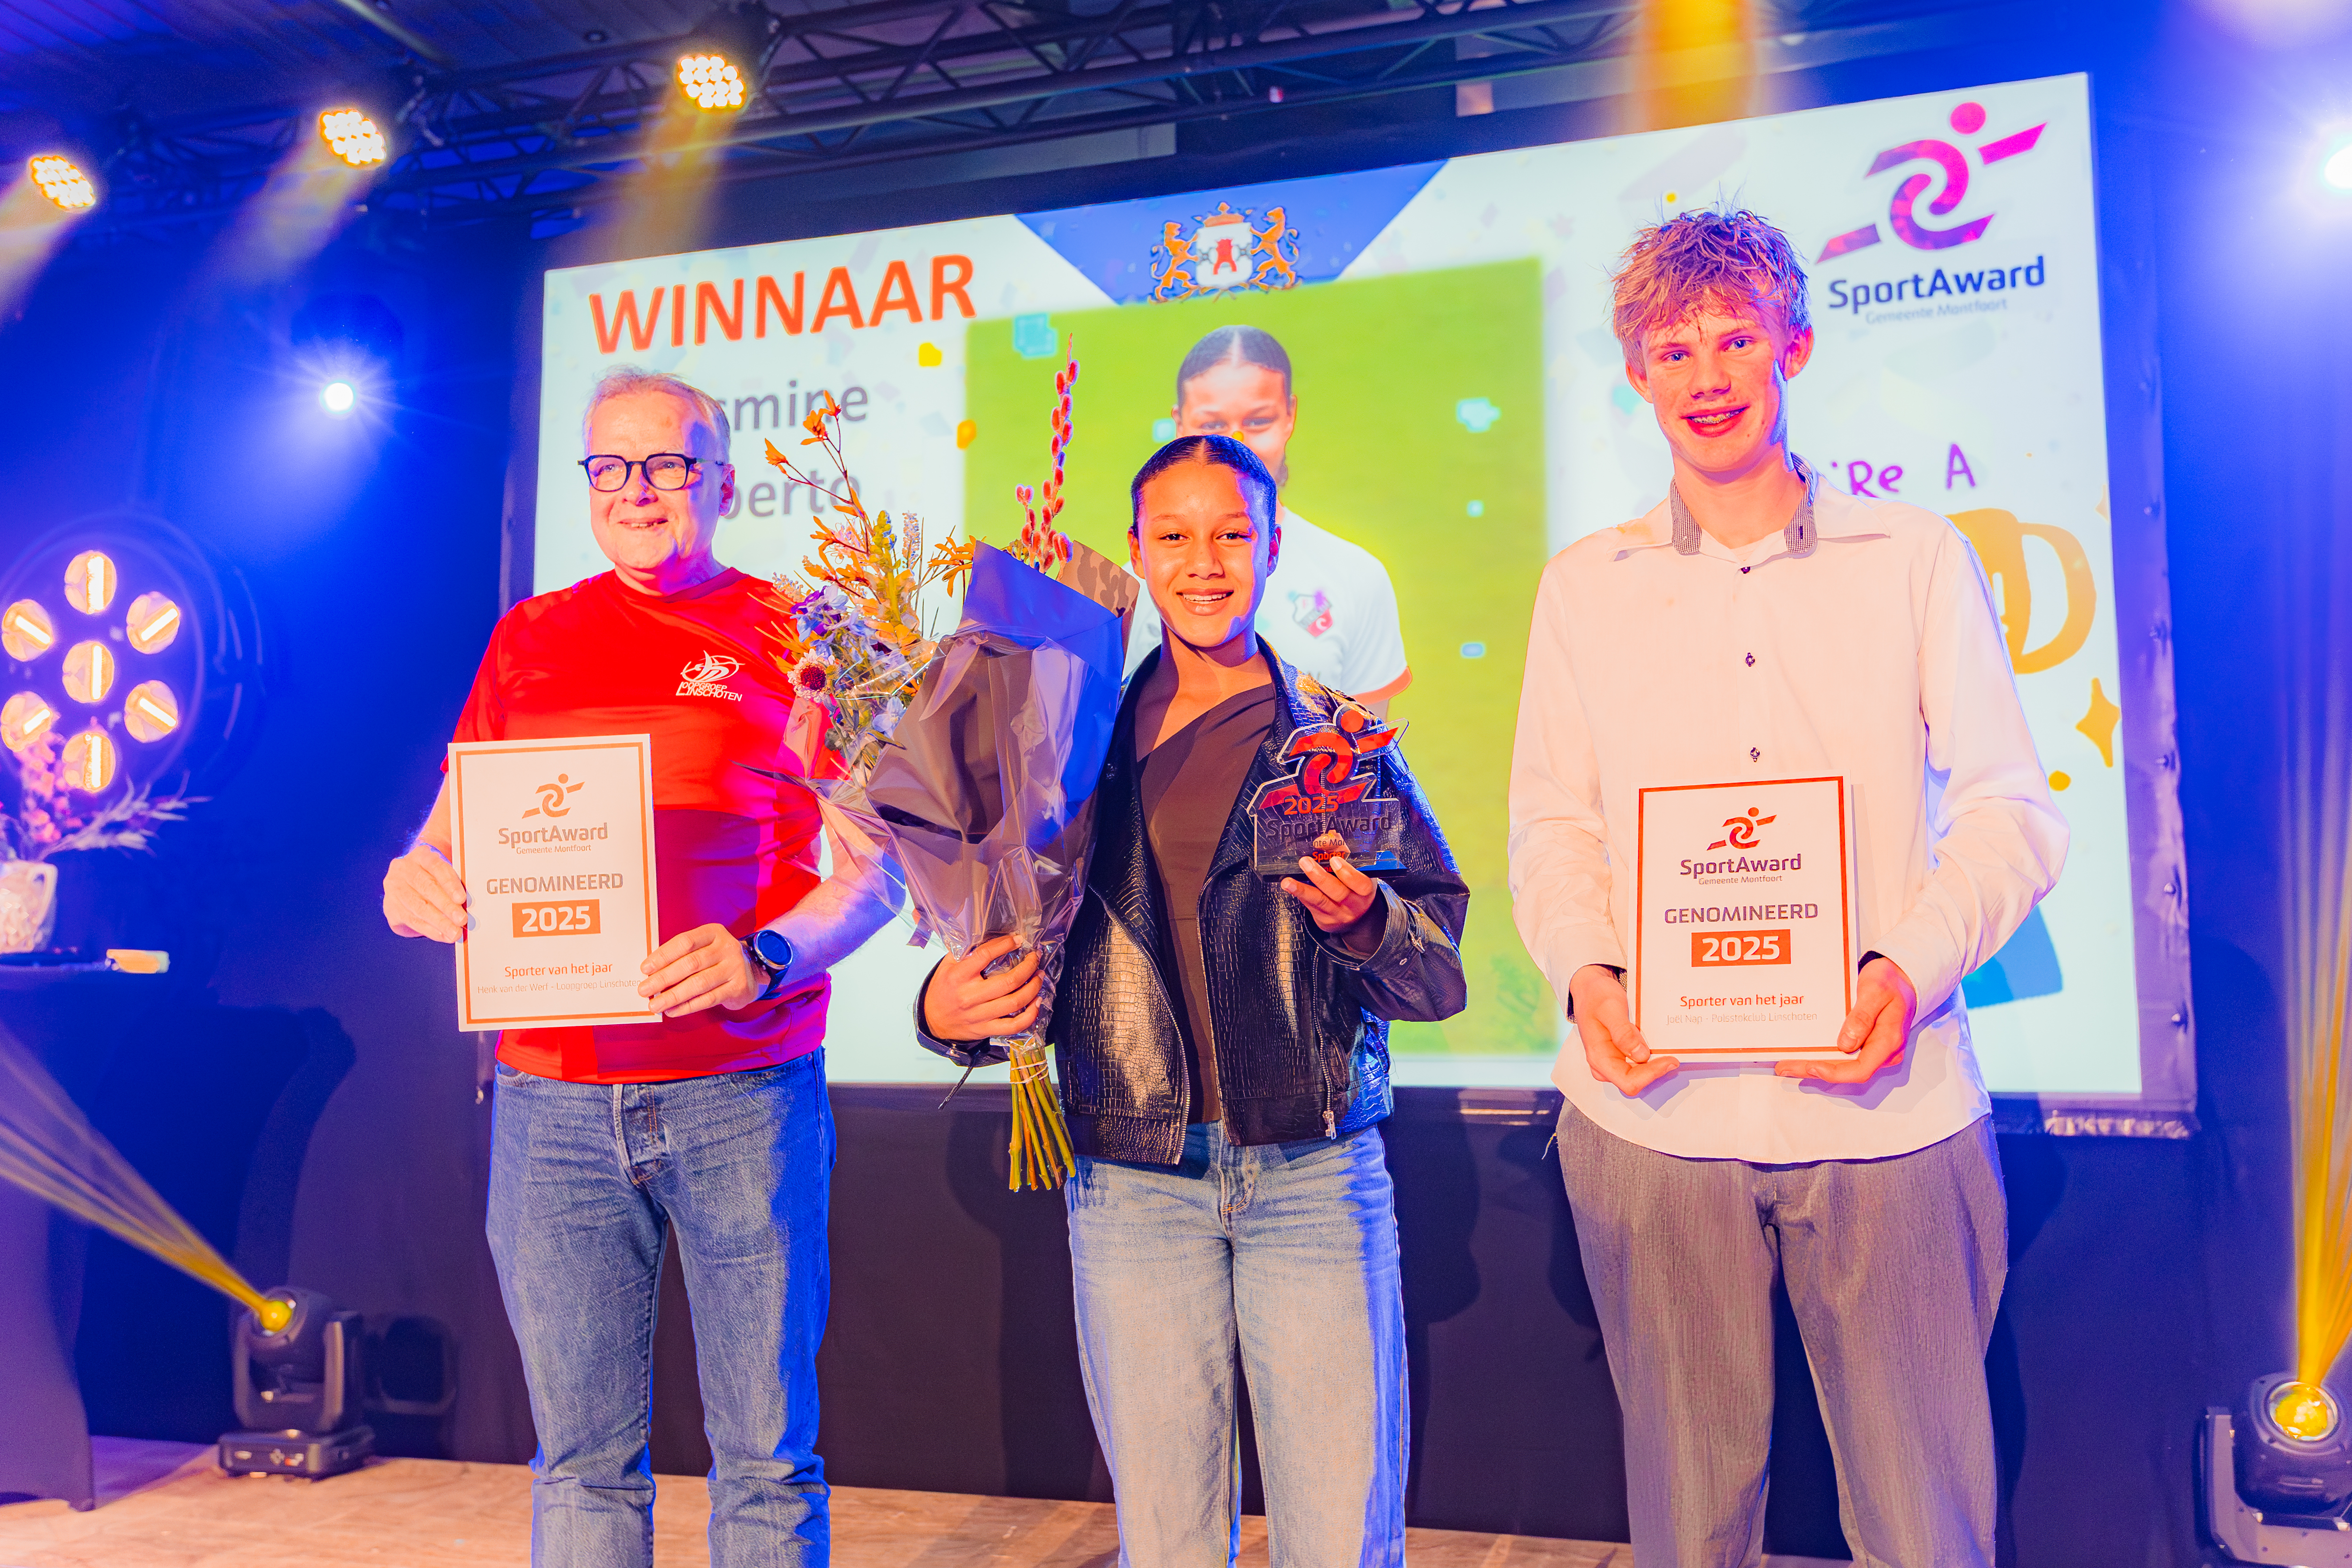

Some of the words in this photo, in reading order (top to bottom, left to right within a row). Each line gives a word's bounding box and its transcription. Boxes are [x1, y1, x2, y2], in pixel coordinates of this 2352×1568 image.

[1828, 255, 2045, 314] SportAward
[589, 253, 977, 355] WINNAAR
[1866, 309, 1933, 325] Gemeente
[1937, 300, 2007, 316] Montfoort
[715, 380, 868, 431] mine
[1946, 444, 1976, 489] A
[676, 683, 743, 701] LINSCHOTEN
[677, 682, 728, 692] LOOPGROEP
[1284, 795, 1339, 815] 2025
[499, 822, 608, 849] SportAward
[1265, 811, 1391, 844] SportAward
[554, 844, 592, 853] Montfoort
[1680, 853, 1801, 879] SportAward
[486, 873, 624, 894] GENOMINEERD
[522, 906, 591, 932] 2025
[1664, 903, 1819, 924] GENOMINEERD
[1701, 935, 1780, 962] 2025
[505, 966, 546, 979] Sporter
[548, 966, 567, 975] van
[571, 963, 589, 974] het
[591, 962, 613, 976] jaar
[477, 985, 498, 994] Henk
[515, 984, 528, 992] der
[530, 982, 549, 991] Werf
[556, 982, 597, 991] Loopgroep
[600, 979, 641, 988] Linschoten
[1680, 996, 1727, 1010] Sporter
[1756, 994, 1777, 1005] het
[1779, 994, 1804, 1008] jaar
[1666, 1014, 1683, 1026] Joël
[1685, 1014, 1703, 1025] Nap
[1712, 1013, 1766, 1022] Polsstokclub
[1769, 1012, 1818, 1021] Linschoten
